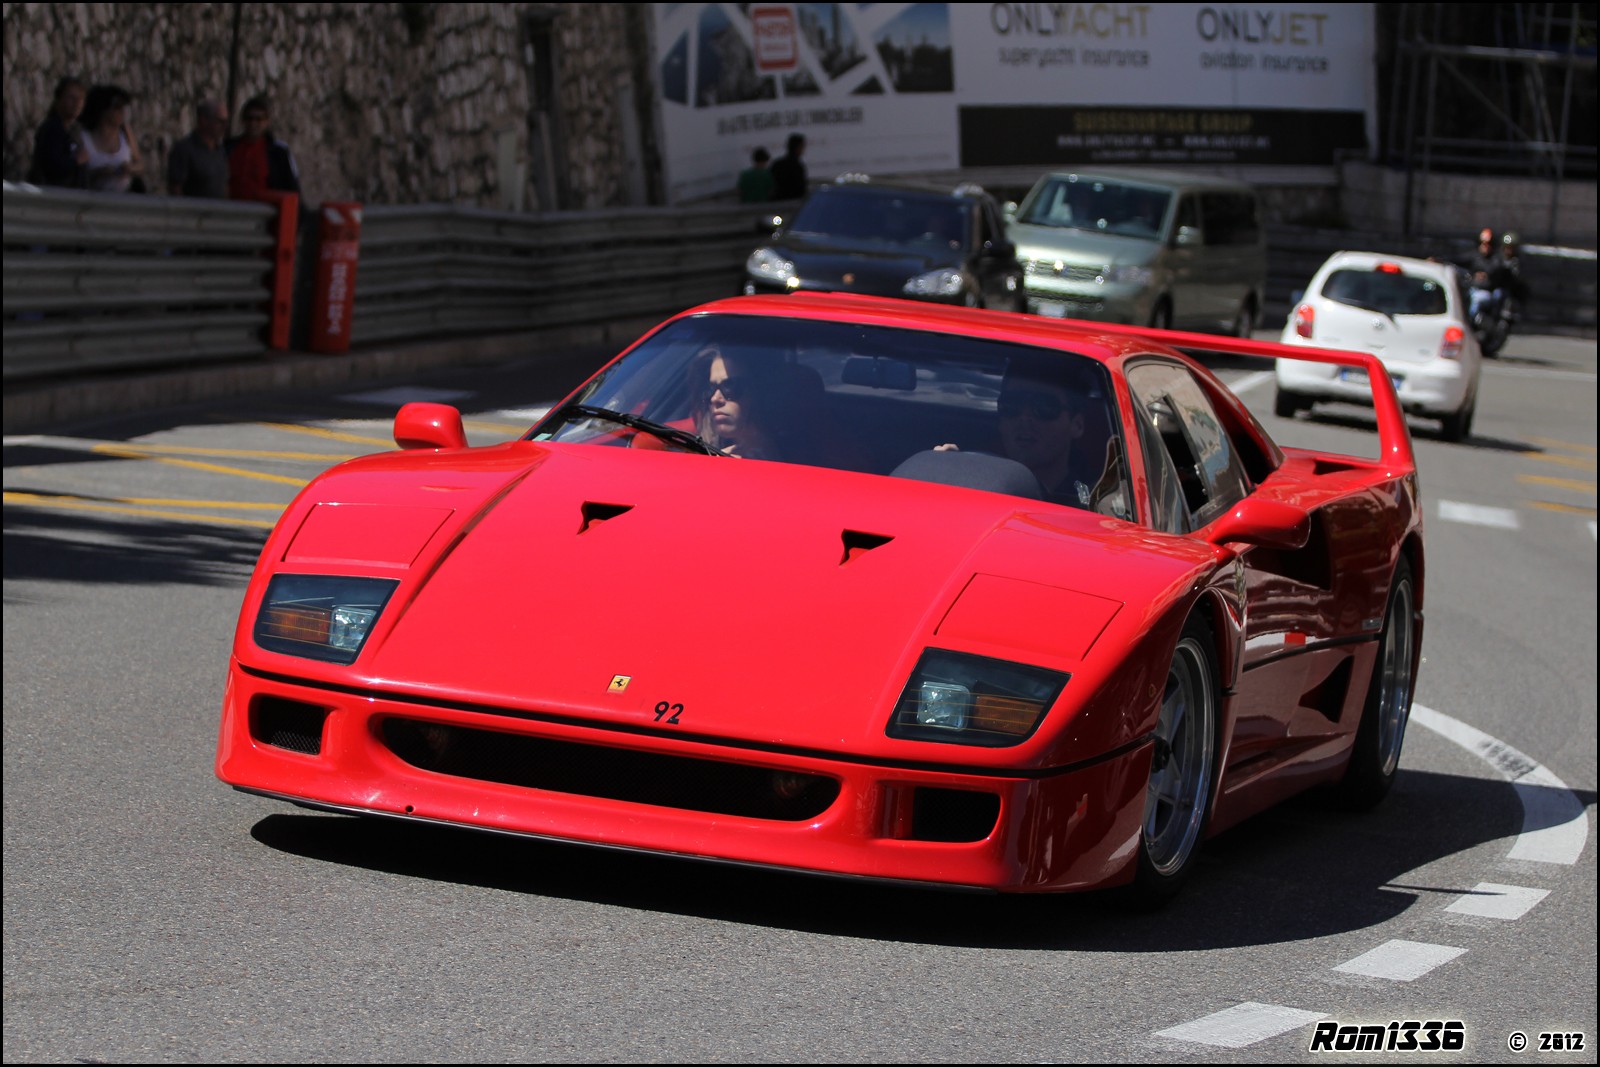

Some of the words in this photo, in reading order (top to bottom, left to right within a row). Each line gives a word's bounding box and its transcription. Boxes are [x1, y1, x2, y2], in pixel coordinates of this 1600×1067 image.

[1195, 8, 1328, 45] ONLYJET
[1081, 46, 1150, 67] insurance
[1200, 50, 1254, 70] aviation
[1261, 50, 1329, 72] insurance
[653, 701, 684, 725] 92
